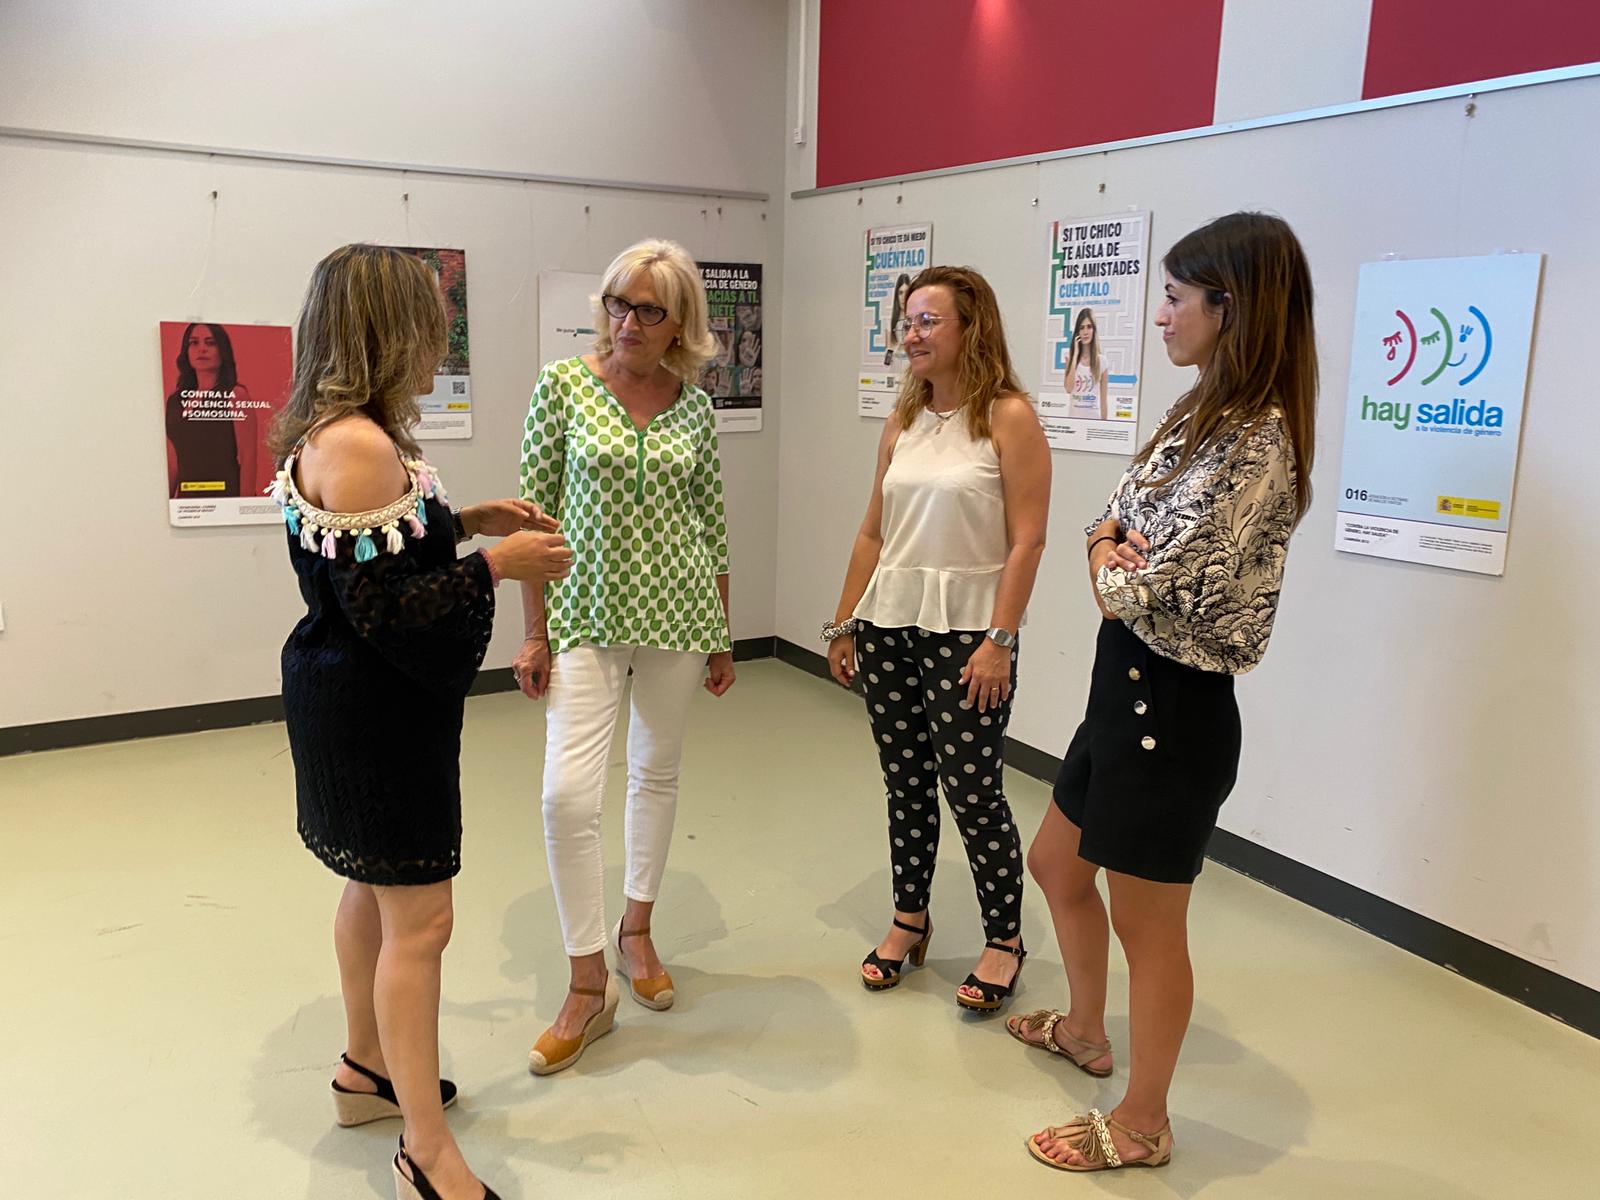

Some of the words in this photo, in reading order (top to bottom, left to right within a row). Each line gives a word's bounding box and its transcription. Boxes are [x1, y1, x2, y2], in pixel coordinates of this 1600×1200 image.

[882, 235, 896, 244] CHICO
[897, 234, 902, 243] TE
[911, 232, 926, 241] MIEDO
[1062, 228, 1072, 242] SI
[1075, 226, 1087, 240] TU
[1090, 222, 1122, 240] CHICO
[1062, 246, 1073, 260] TE
[1075, 241, 1104, 260] AÍSLA
[1106, 242, 1120, 257] DE
[875, 247, 925, 269] CUÉNTALO
[705, 268, 732, 279] SALIDA
[733, 269, 738, 279] A
[740, 269, 749, 279] LA
[1062, 264, 1079, 279] TUS
[1081, 259, 1140, 278] AMISTADES
[703, 280, 718, 289] CIA
[719, 280, 729, 289] DE
[1059, 280, 1110, 298] CUÉNTALO
[708, 290, 737, 303] ACIAS
[738, 291, 745, 304] A
[711, 304, 736, 317] NETE
[180, 390, 222, 398] CONTRA
[223, 391, 236, 399] LA
[181, 400, 234, 408] VIOLENCIA
[235, 400, 271, 409] SEXUAL
[182, 410, 248, 418] #SOMOSUNA.
[1361, 395, 1411, 430] hay
[1416, 398, 1504, 428] salida
[1430, 426, 1461, 435] violencia
[1463, 427, 1473, 435] de
[1474, 427, 1502, 437] género
[1346, 488, 1368, 501] 016
